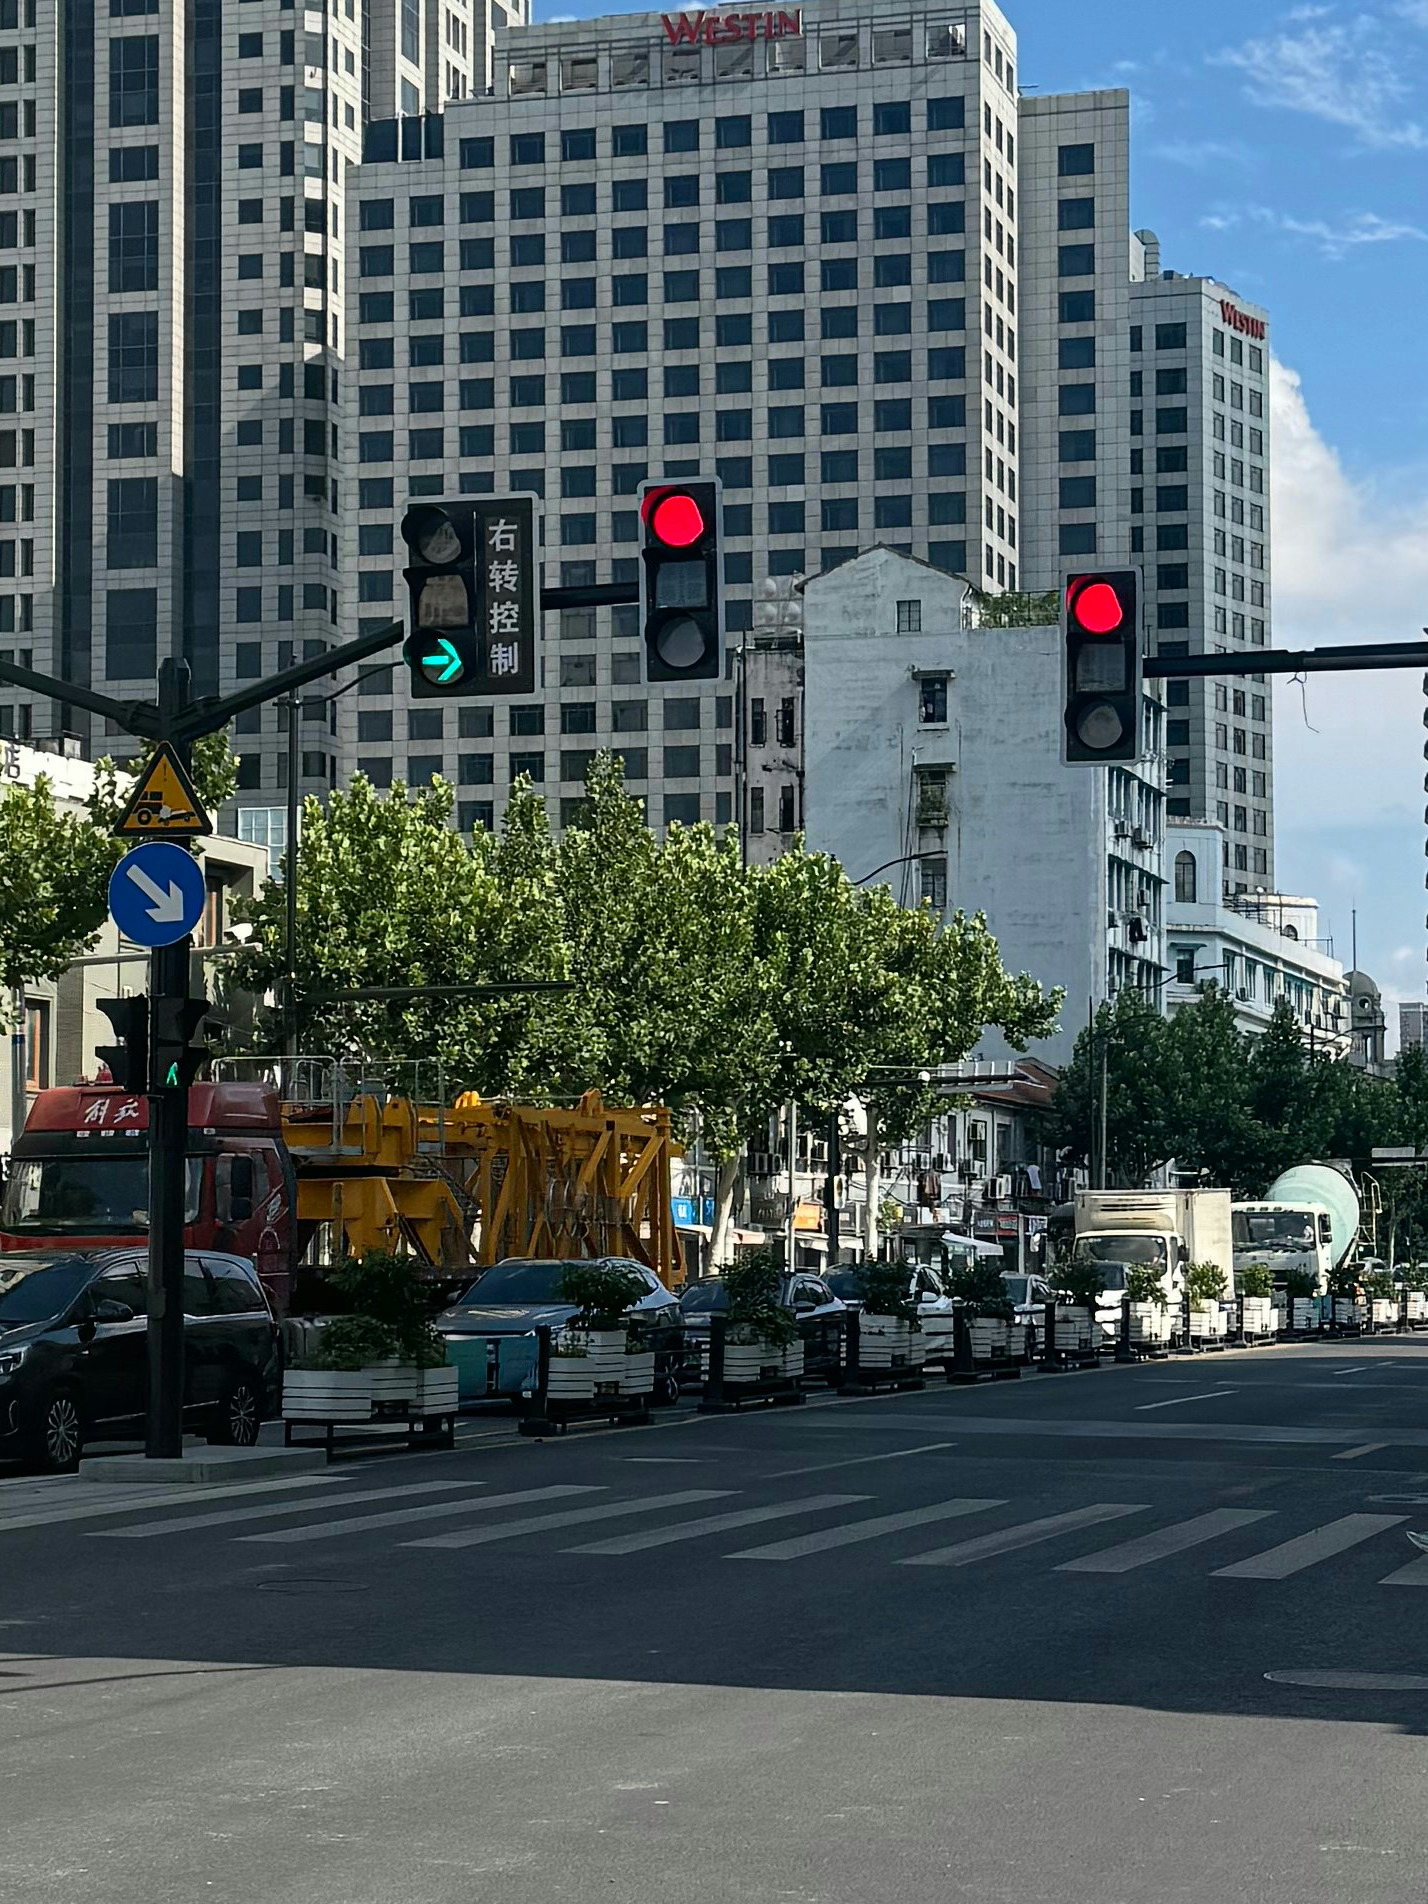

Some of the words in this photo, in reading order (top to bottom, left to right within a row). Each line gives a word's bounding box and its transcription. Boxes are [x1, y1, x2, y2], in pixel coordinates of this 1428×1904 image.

[661, 9, 802, 46] WESTIN
[1220, 299, 1265, 341] WESTIN
[488, 519, 519, 675] 右转控制
